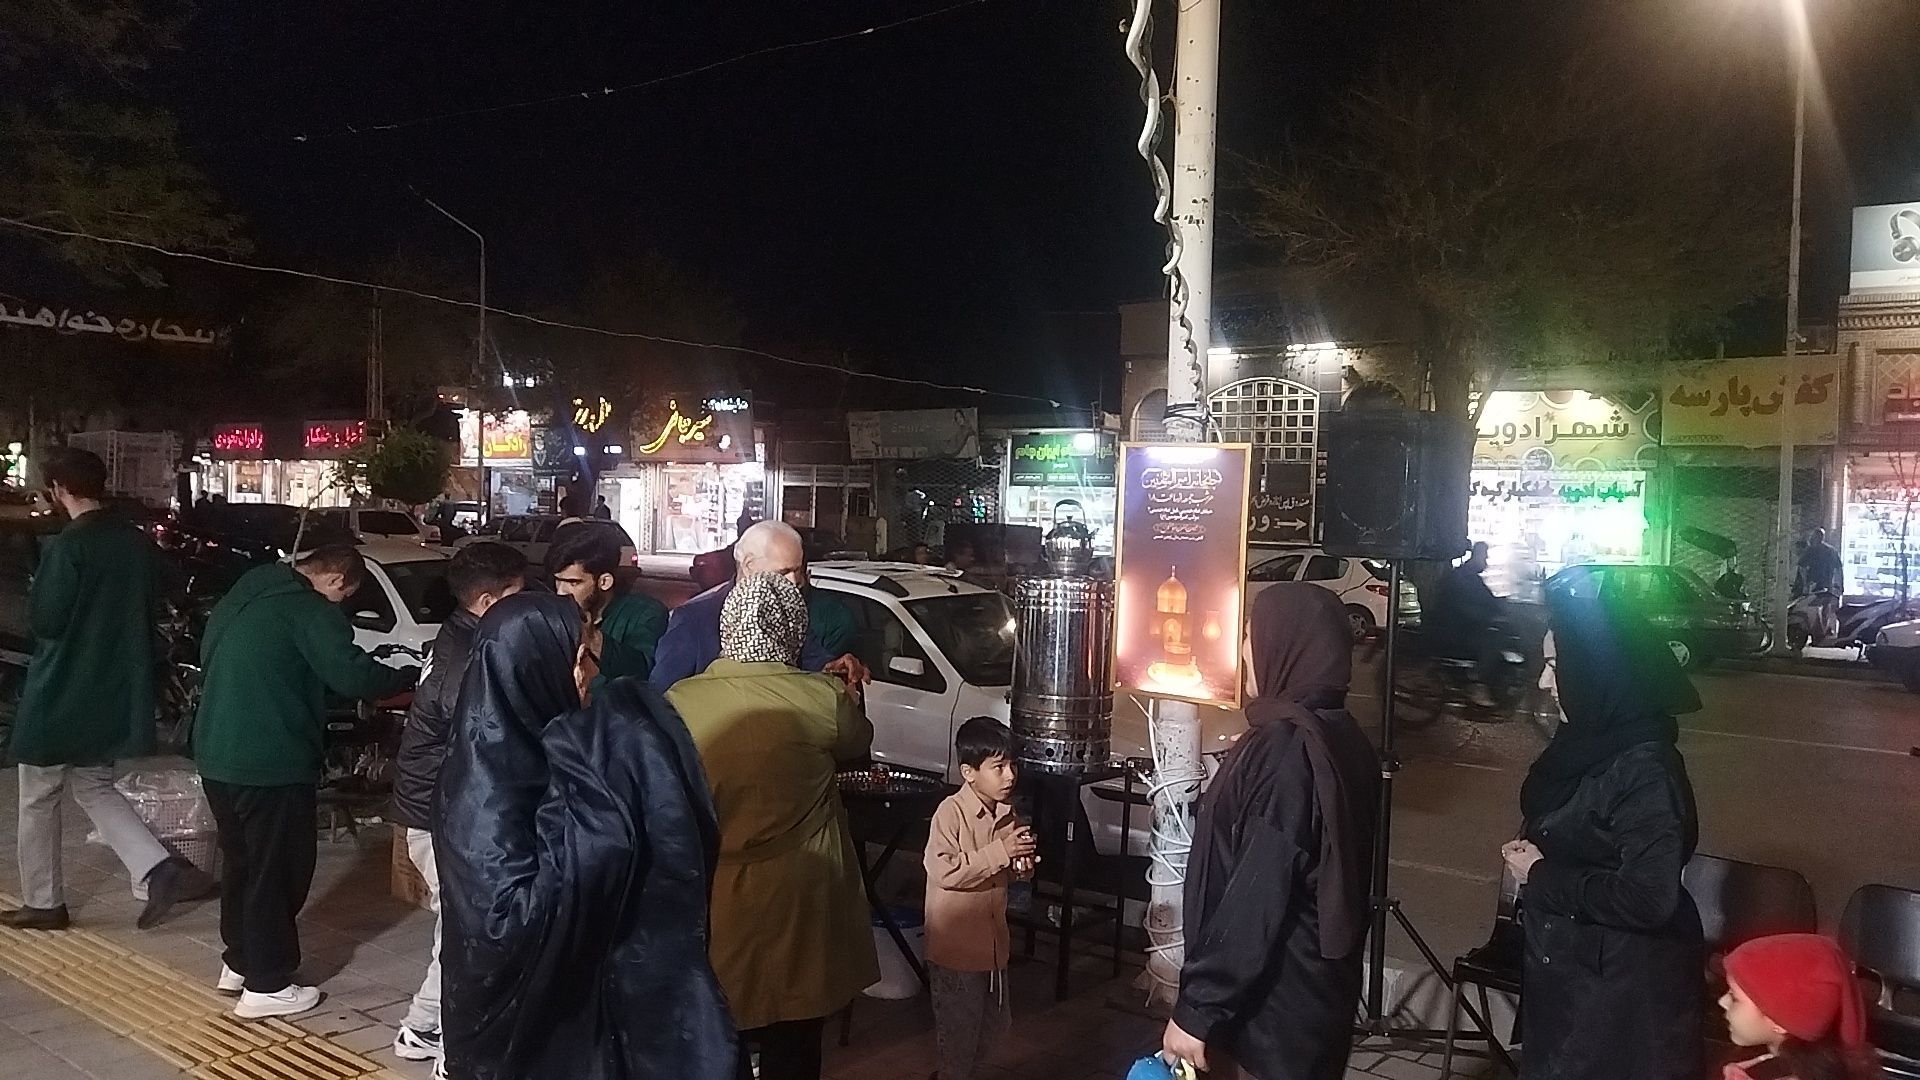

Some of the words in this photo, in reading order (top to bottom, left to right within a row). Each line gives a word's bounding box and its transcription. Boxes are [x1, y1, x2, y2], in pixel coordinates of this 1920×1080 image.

[1669, 376, 1750, 417] پارسه
[1477, 416, 1541, 445] ادوی
[1545, 410, 1630, 444] شهر
